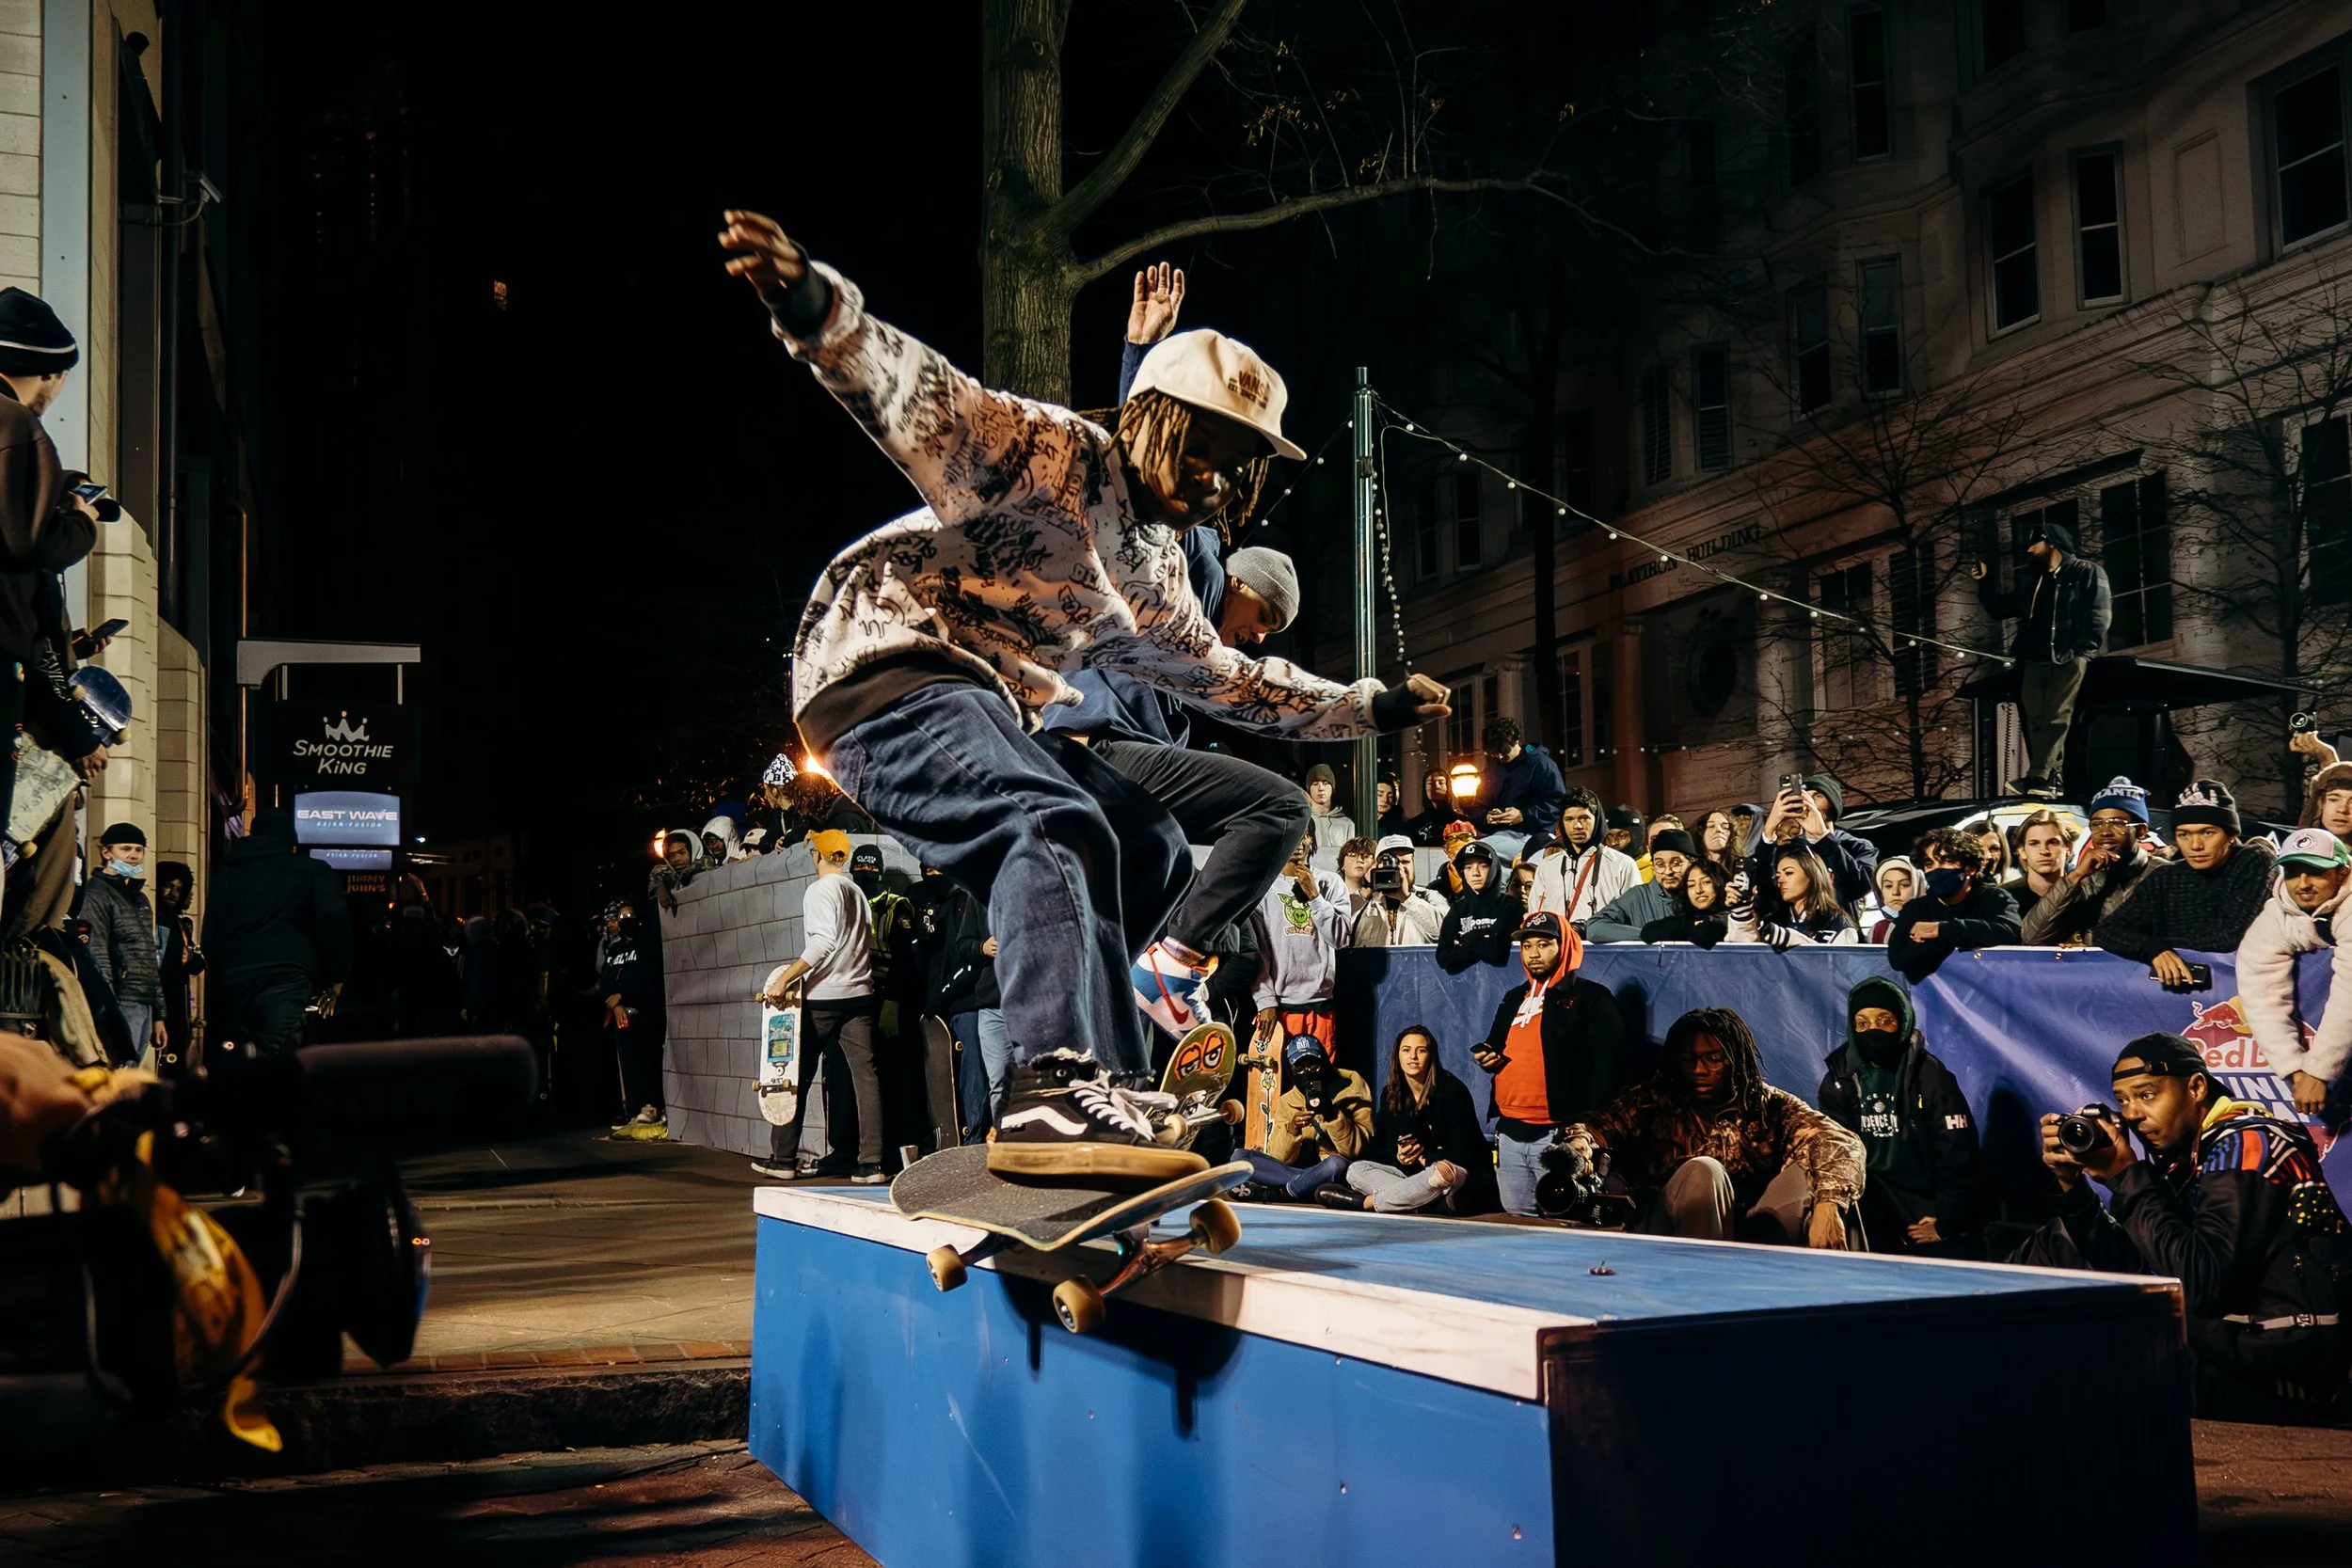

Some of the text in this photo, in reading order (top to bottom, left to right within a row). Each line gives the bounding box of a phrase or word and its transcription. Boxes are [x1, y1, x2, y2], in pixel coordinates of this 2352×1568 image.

[1239, 371, 1264, 397] VANS
[1686, 524, 1760, 562] BUILDING
[293, 739, 394, 758] SMOOTHIE
[296, 809, 398, 821] EAST WAVE
